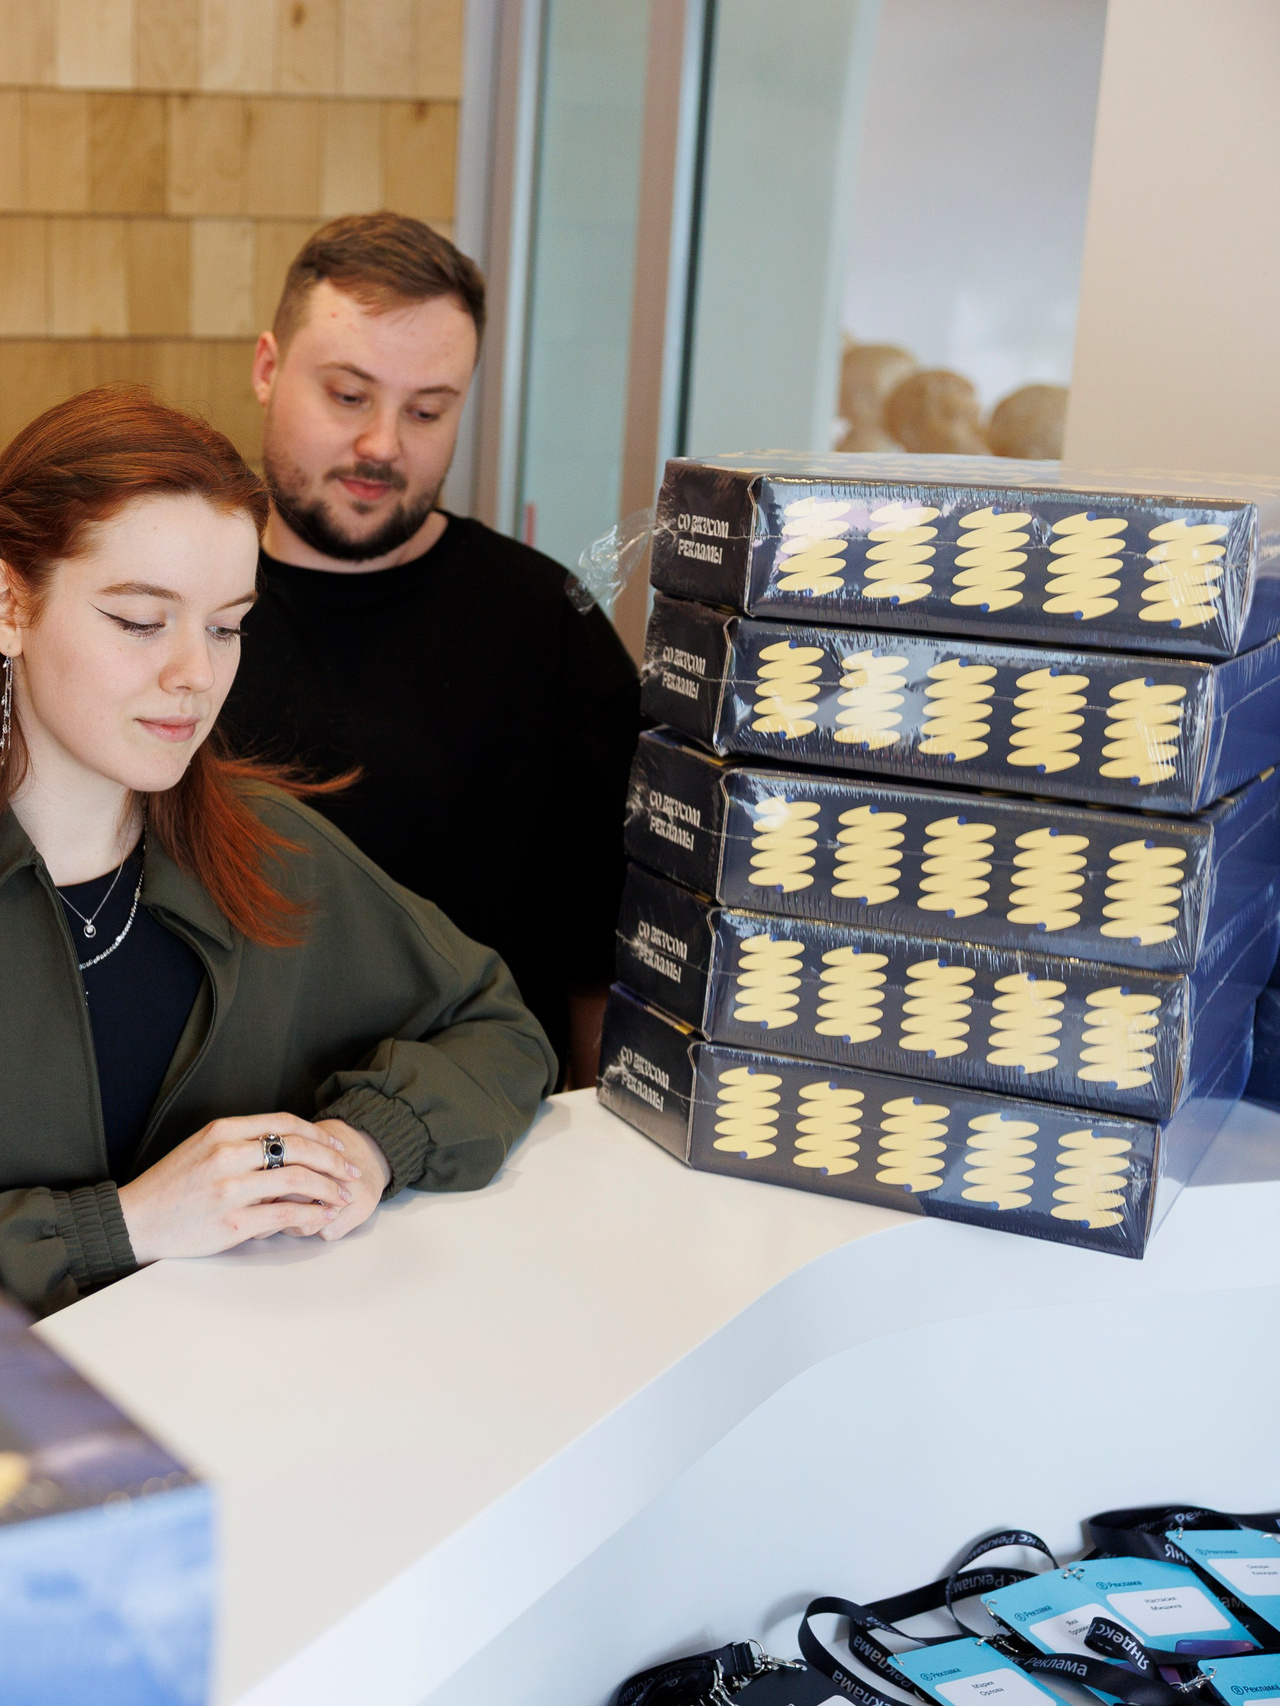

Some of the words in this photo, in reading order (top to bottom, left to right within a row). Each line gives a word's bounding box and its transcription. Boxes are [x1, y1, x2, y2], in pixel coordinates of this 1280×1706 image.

[1095, 1624, 1150, 1671] Яндекс
[1024, 1656, 1088, 1677] Реклама
[1243, 1685, 1280, 1694] Реклама
